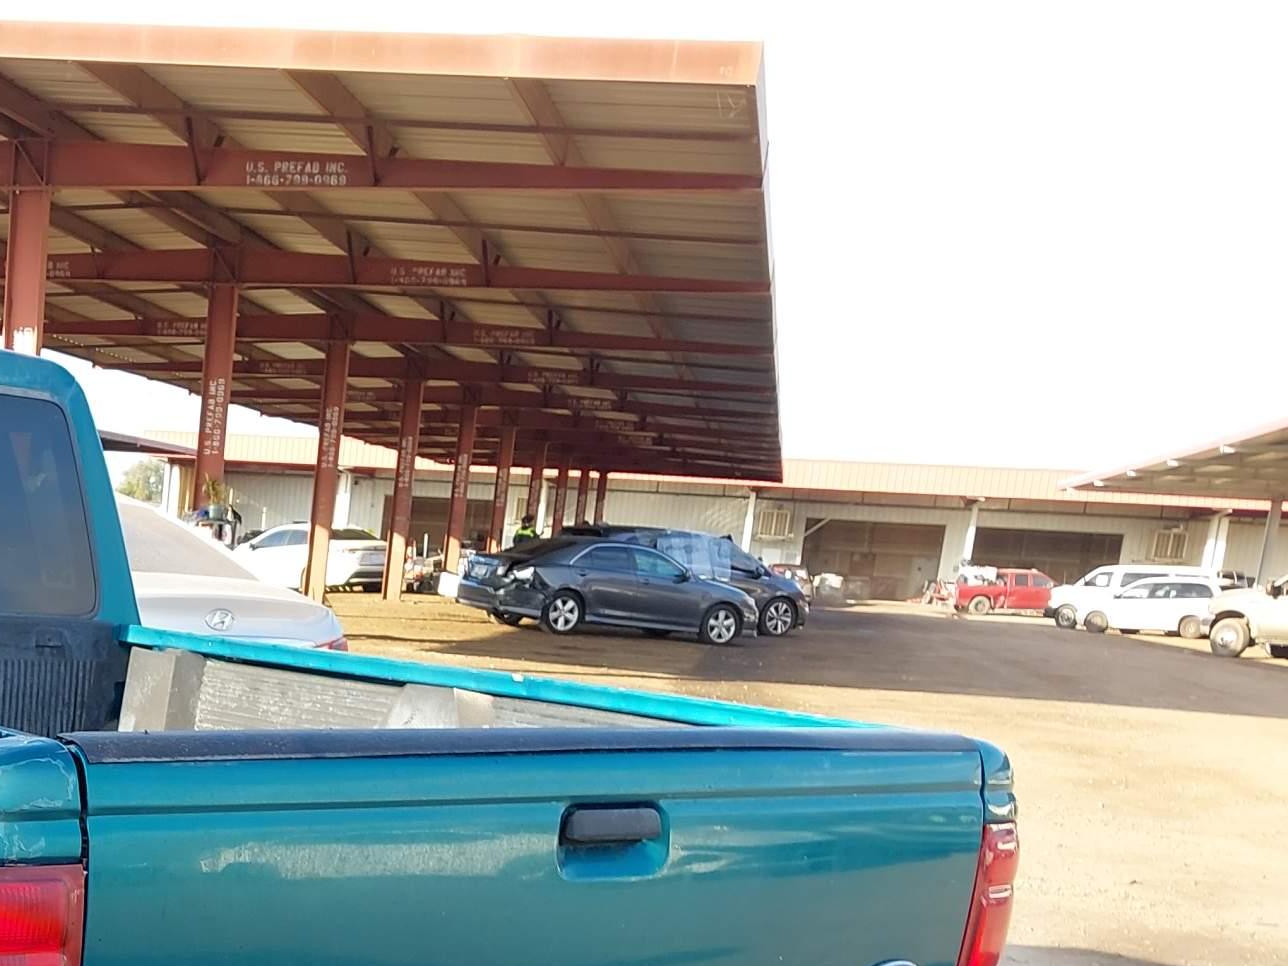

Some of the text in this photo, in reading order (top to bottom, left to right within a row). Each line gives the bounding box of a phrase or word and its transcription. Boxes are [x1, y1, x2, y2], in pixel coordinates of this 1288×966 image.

[246, 161, 268, 173] U.S.
[274, 161, 319, 173] PREFAB
[205, 398, 215, 434] PREFAB
